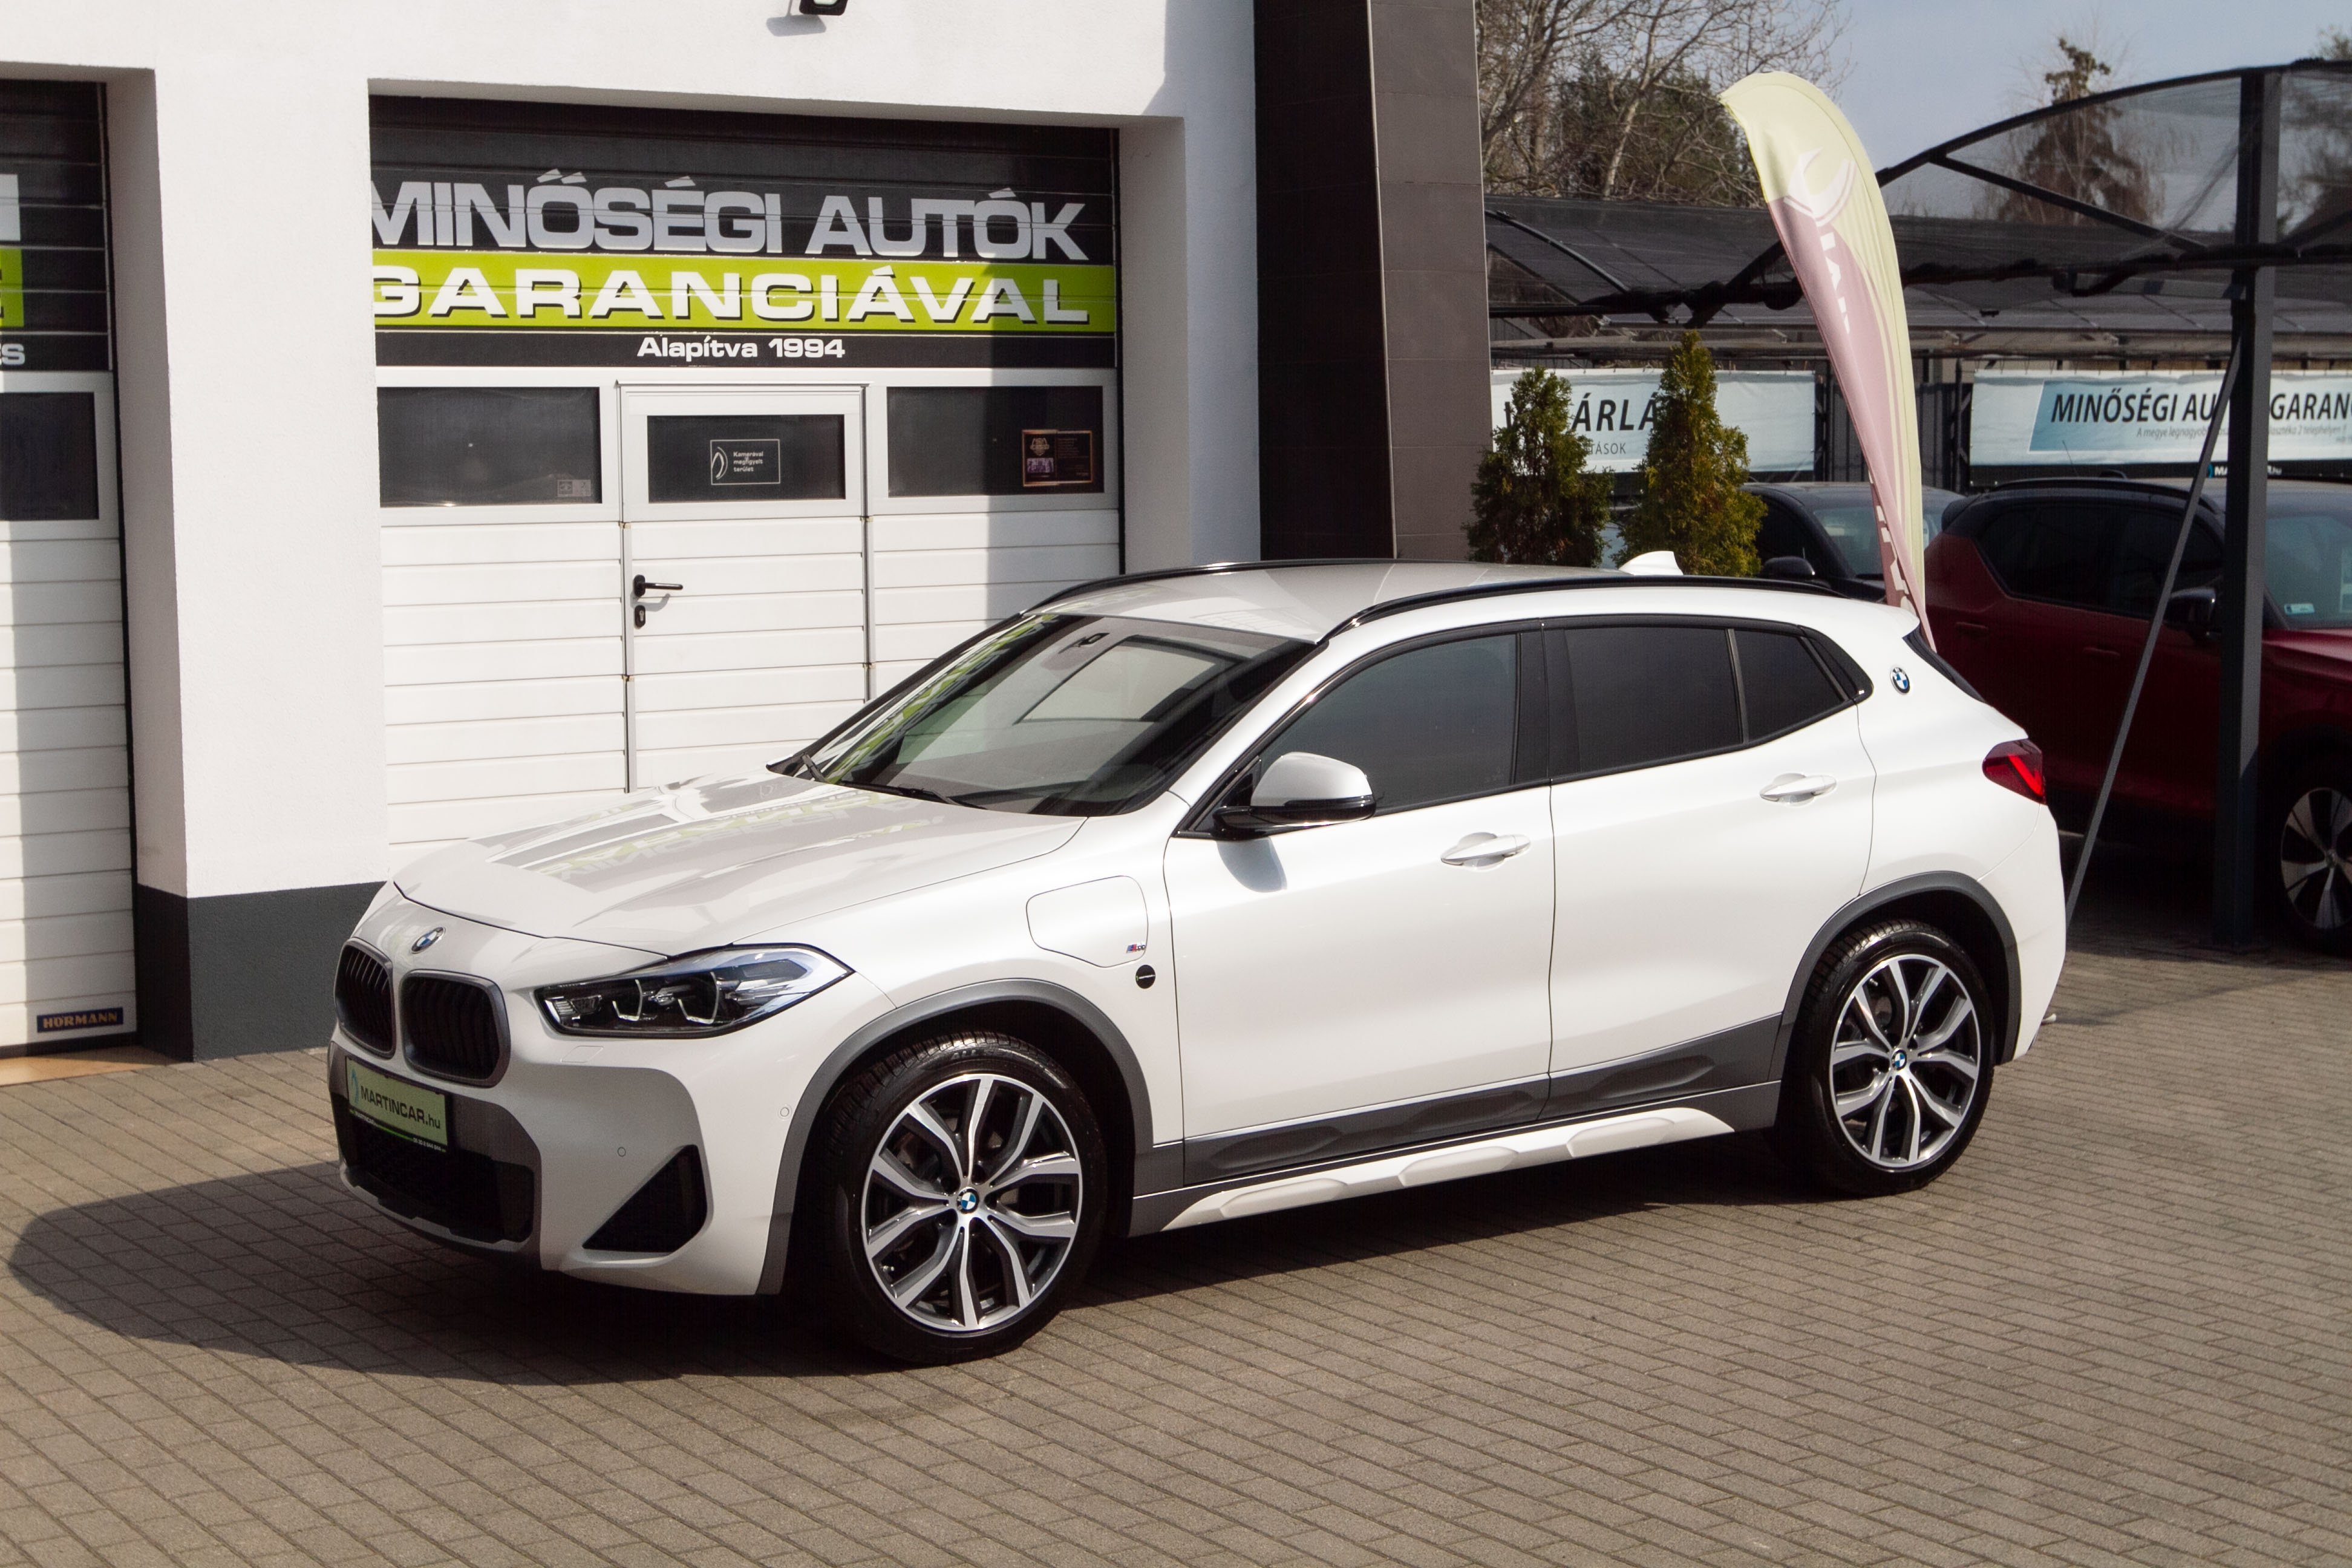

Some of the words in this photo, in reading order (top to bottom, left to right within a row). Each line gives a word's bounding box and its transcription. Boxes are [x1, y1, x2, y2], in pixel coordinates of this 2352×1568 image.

[370, 168, 783, 253] MINŐSÉGI
[805, 188, 1089, 260] AUTÓK
[373, 265, 1089, 324] GARANCIÁVAL
[637, 336, 758, 362] Alapítva
[768, 338, 845, 359] 1994
[2051, 387, 2178, 422] MINŐSÉGI
[2270, 393, 2352, 420] GARAN
[361, 1085, 441, 1129] MARTINCAR.hu
